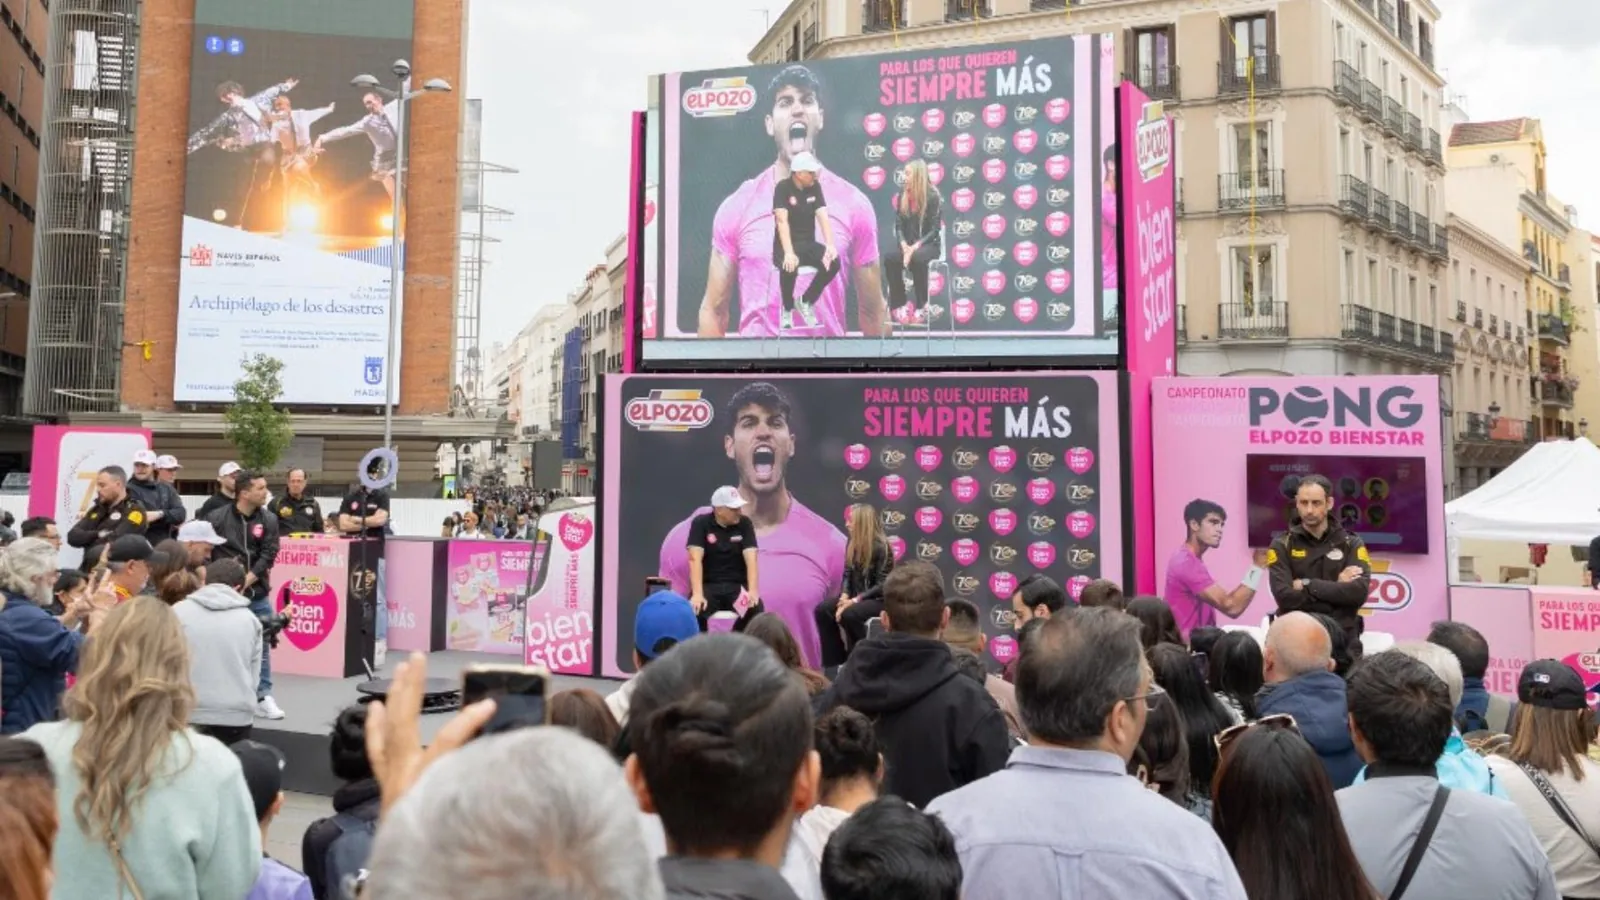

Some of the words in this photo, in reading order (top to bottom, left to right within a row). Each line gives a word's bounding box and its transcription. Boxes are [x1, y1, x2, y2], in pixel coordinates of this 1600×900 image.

[880, 61, 909, 76] PARA
[912, 59, 935, 73] LOS
[938, 56, 961, 71] QUE
[964, 50, 1017, 67] QUIEREN
[879, 69, 987, 106] SIEMPRE
[996, 55, 1053, 96] MÁS
[1136, 200, 1173, 276] bien
[189, 294, 280, 316] Archipiélago
[283, 297, 300, 312] de
[303, 298, 323, 313] los
[325, 299, 384, 315] desastres
[1144, 265, 1172, 342] star
[864, 388, 899, 402] PARA
[904, 388, 930, 403] LOS
[934, 388, 961, 403] QUE
[966, 387, 1029, 403] QUIEREN
[1167, 387, 1246, 399] CAMPEONATO
[864, 406, 993, 438] SIEMPRE
[1004, 396, 1072, 438] MÁS
[1249, 386, 1423, 428] PONG
[1249, 430, 1323, 444] ELPOZO
[1329, 430, 1425, 445] BIENSTAR
[275, 551, 318, 566] SIEMPRE
[291, 601, 324, 619] bien
[1539, 600, 1565, 610] PARA
[1567, 601, 1585, 611] LOS
[1588, 602, 1600, 612] QU
[388, 606, 416, 629] MÁS
[527, 609, 593, 646] bien
[1541, 612, 1600, 632] SIEMP
[531, 637, 592, 670] star
[1490, 657, 1505, 669] RA
